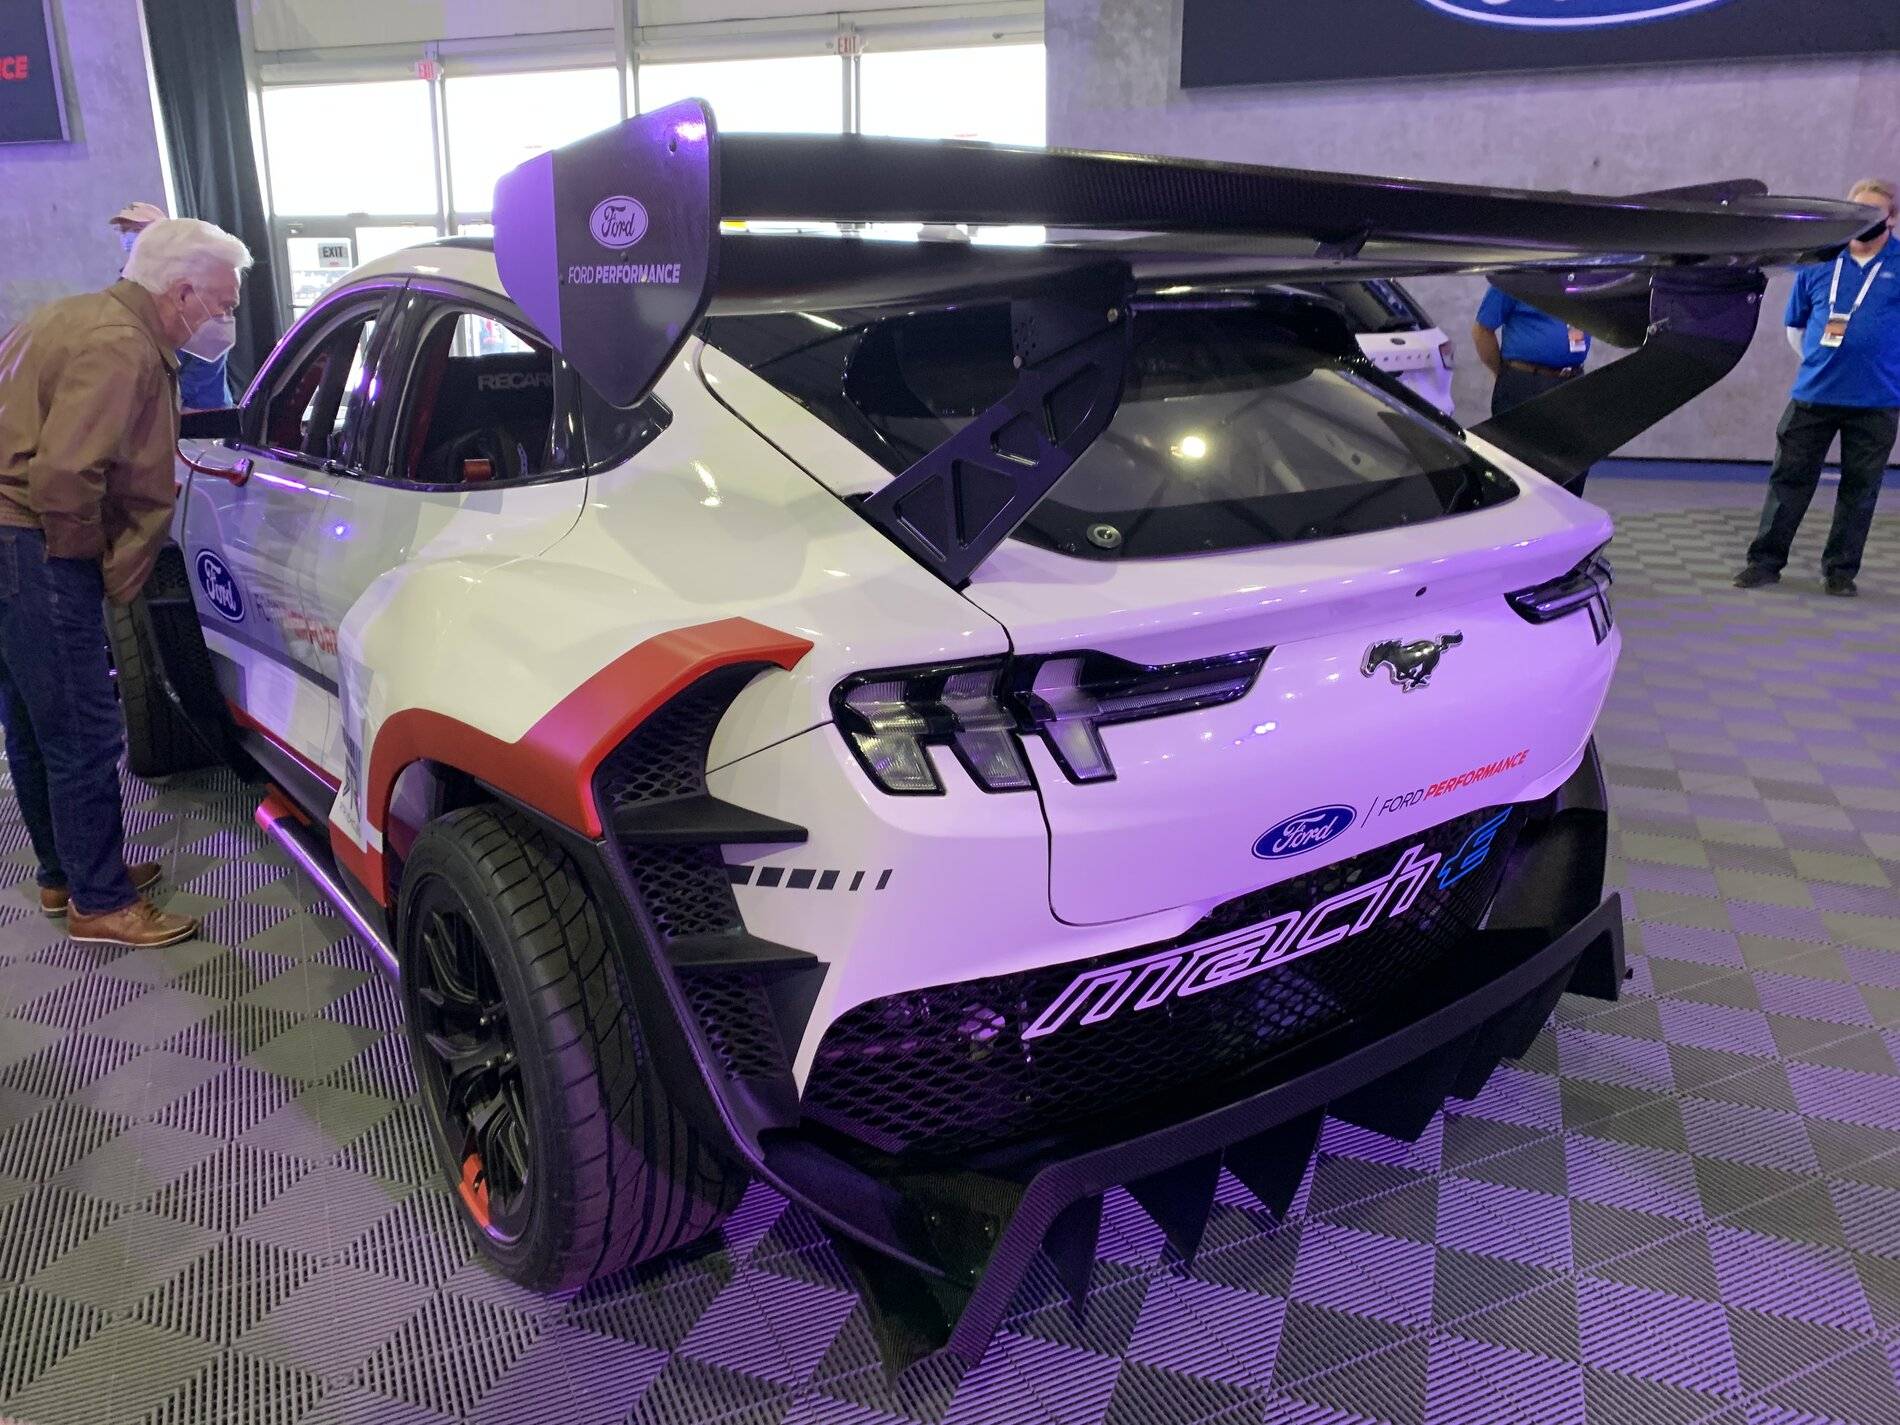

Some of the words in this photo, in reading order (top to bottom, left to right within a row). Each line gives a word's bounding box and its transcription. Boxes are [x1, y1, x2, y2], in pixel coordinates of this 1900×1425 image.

[600, 206, 636, 238] Ford
[322, 246, 344, 258] EXIT
[568, 266, 594, 284] FORD
[596, 264, 681, 284] PERFORMANCE
[203, 558, 237, 611] Ford
[1272, 813, 1339, 854] Ford
[1379, 788, 1425, 817] FORD
[1422, 748, 1531, 801] PERFORMANCE
